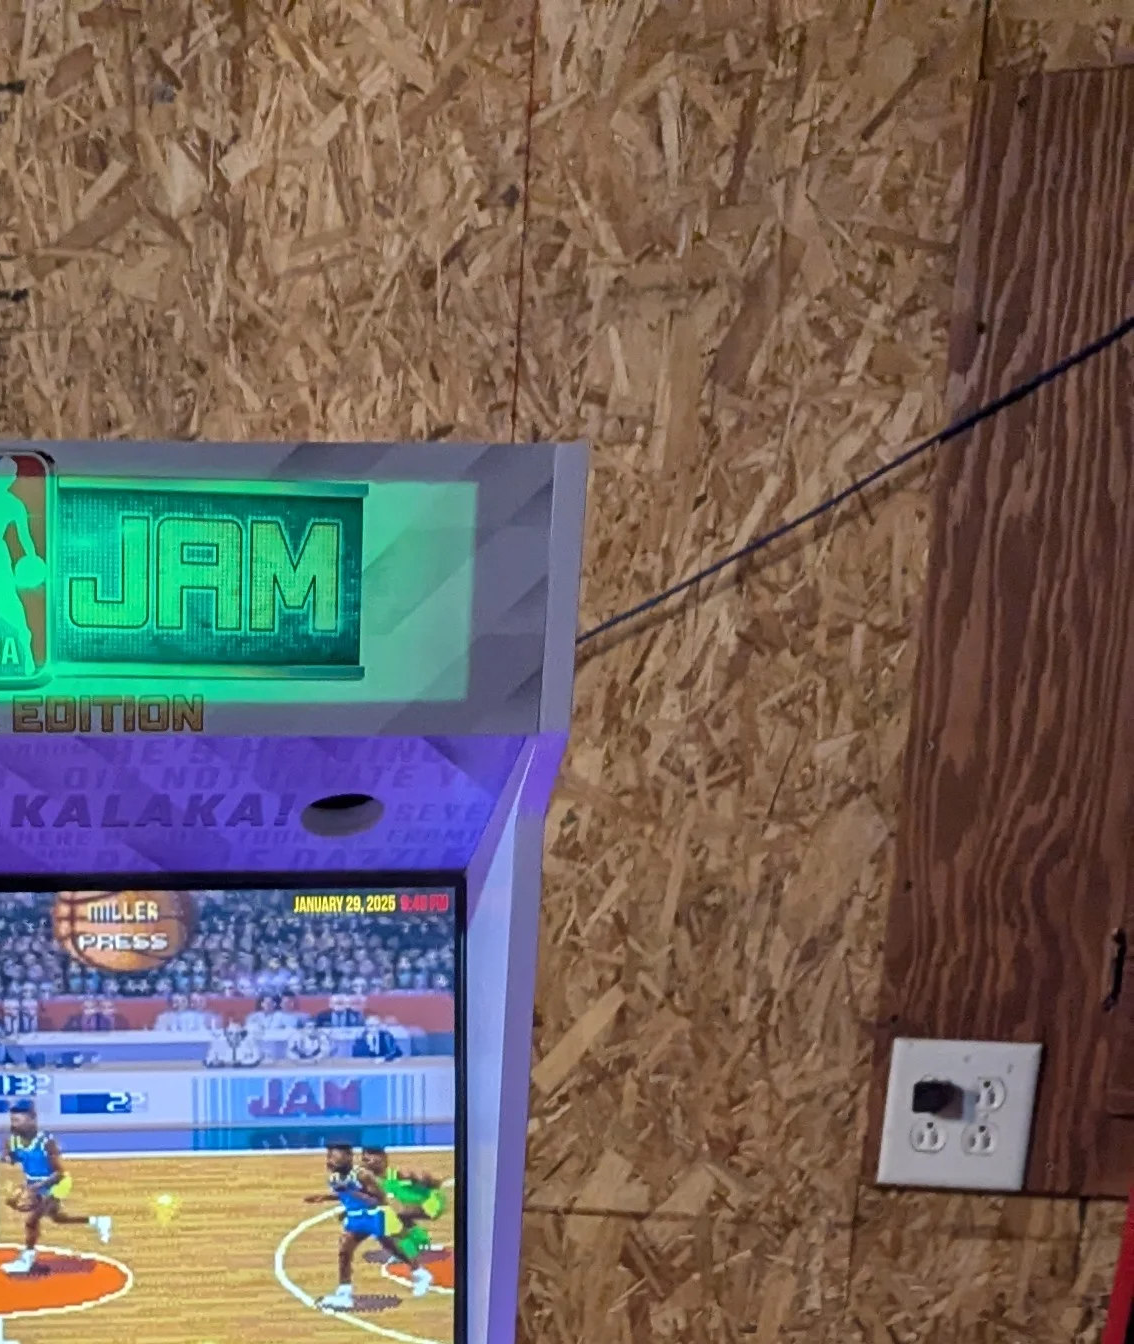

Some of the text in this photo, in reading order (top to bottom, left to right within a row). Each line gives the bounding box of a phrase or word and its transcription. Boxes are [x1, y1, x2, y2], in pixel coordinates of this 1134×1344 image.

[68, 514, 341, 633] JAM
[12, 695, 205, 733] EDITION
[86, 901, 159, 923] MILLER
[293, 895, 344, 914] JANUARY
[346, 895, 367, 914] 29,
[77, 934, 169, 951] PRESS
[247, 1078, 363, 1118] JAM
